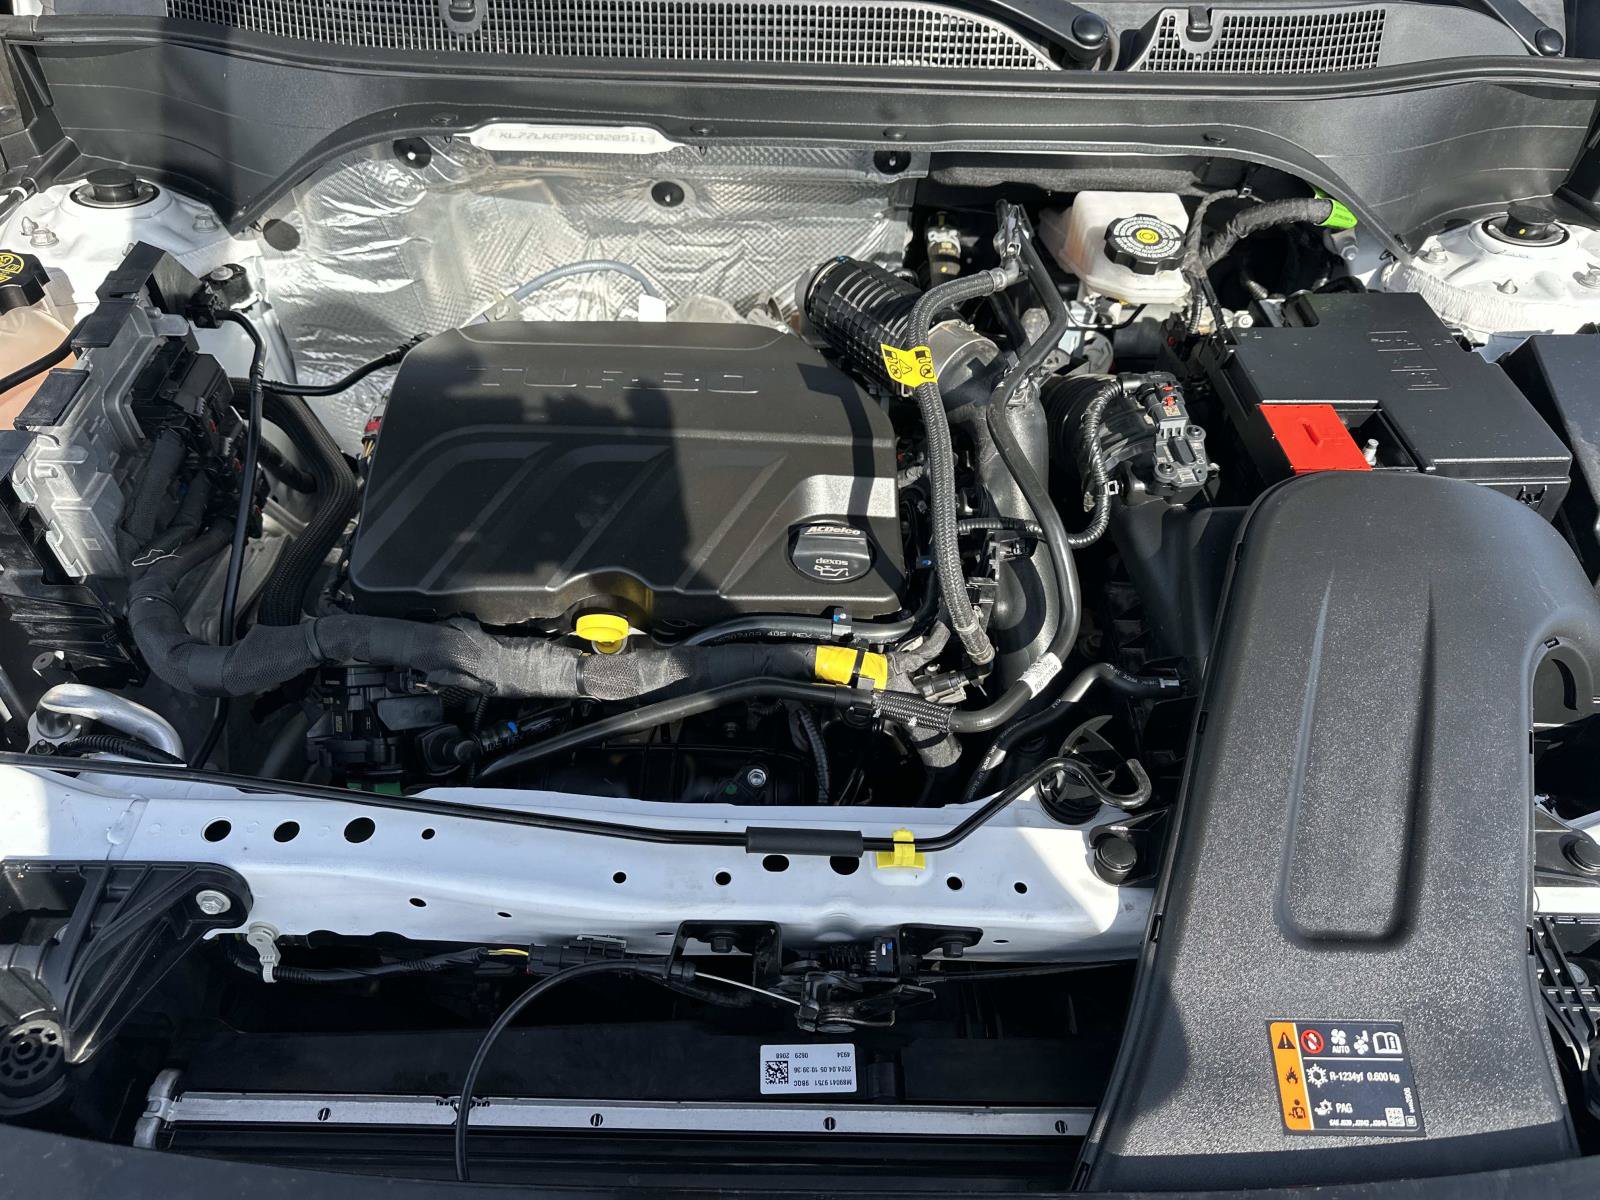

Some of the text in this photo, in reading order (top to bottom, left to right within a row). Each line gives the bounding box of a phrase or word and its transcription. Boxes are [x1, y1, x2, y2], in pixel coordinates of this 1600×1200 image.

[467, 367, 760, 394] TURBO
[805, 526, 861, 535] ACDelco
[815, 557, 849, 566] dexos
[1332, 1046, 1350, 1054] AUTO
[1366, 1071, 1388, 1082] 0.600
[1389, 1072, 1400, 1084] kg
[1335, 1102, 1353, 1114] PAG
